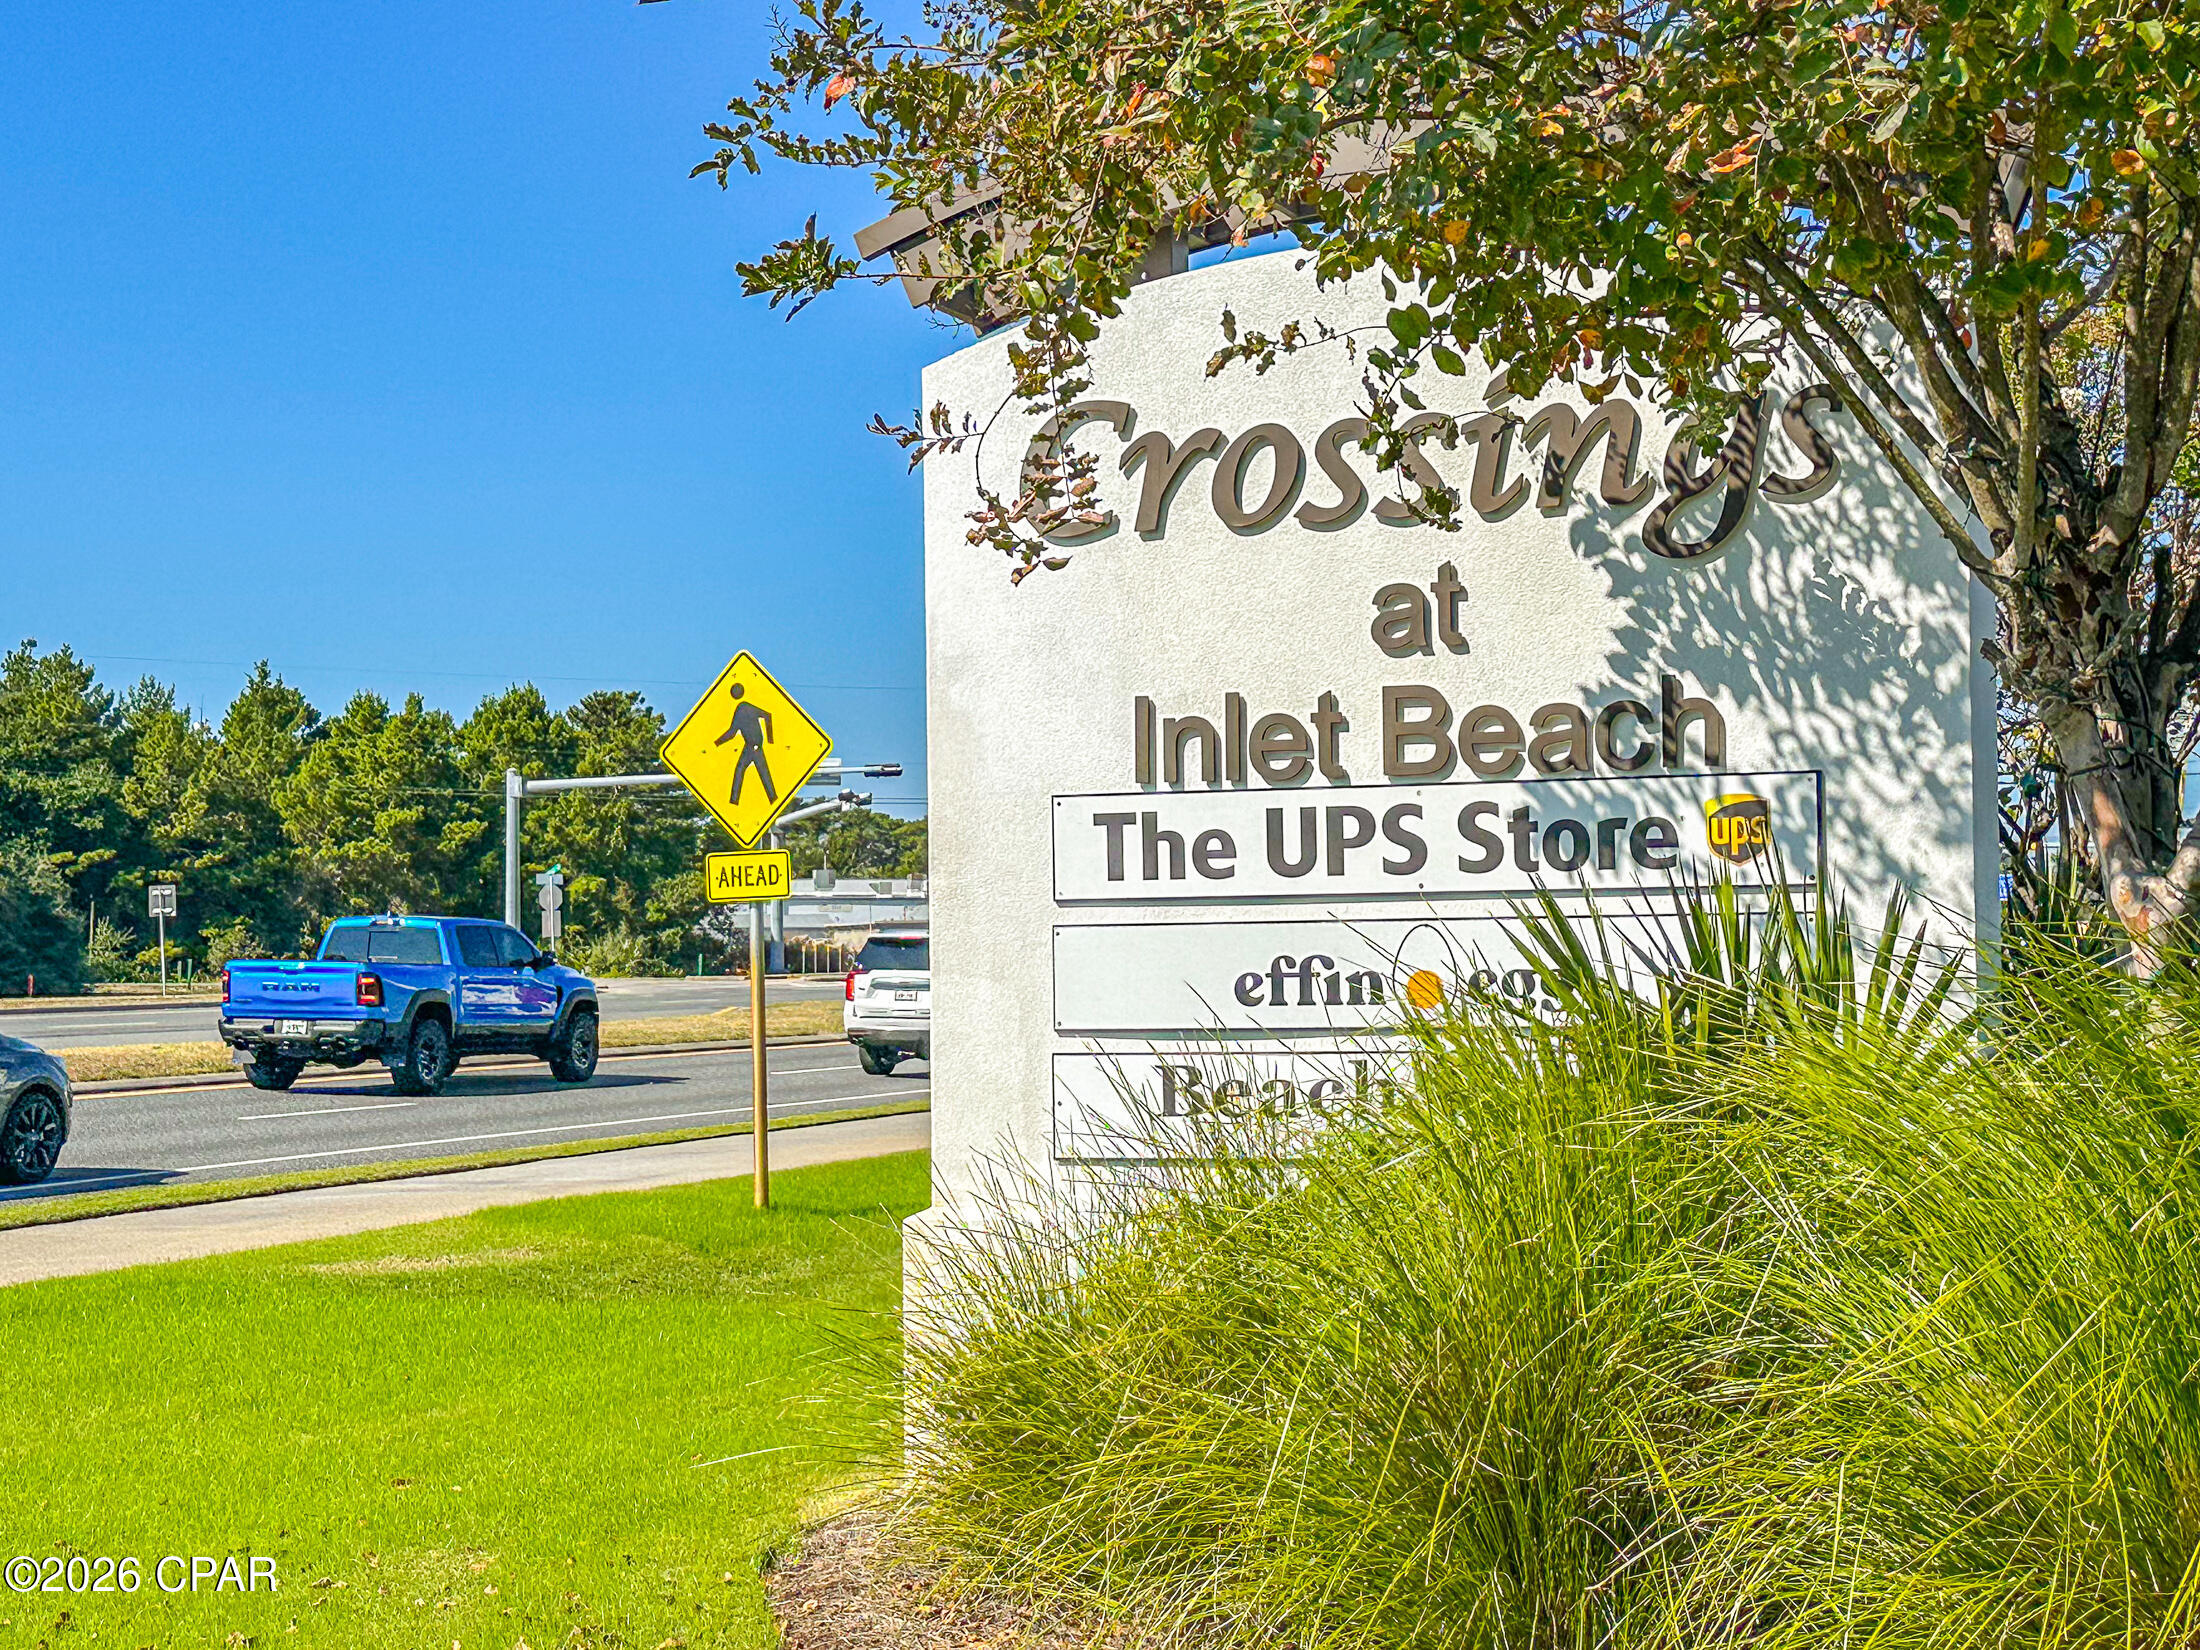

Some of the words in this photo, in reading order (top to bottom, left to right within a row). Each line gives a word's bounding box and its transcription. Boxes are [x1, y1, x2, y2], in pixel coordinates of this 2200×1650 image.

[1020, 372, 1843, 558] Crossings
[1371, 560, 1469, 658] at
[1134, 690, 1350, 790] Inlet
[1382, 674, 1727, 784] Beach
[1093, 811, 1237, 881] The
[1266, 803, 1428, 878] UPS
[1457, 800, 1680, 873] Store
[1711, 816, 1768, 855] ups
[718, 864, 780, 888] AHEAD
[262, 981, 321, 993] RAM
[1234, 955, 1387, 1007] effin
